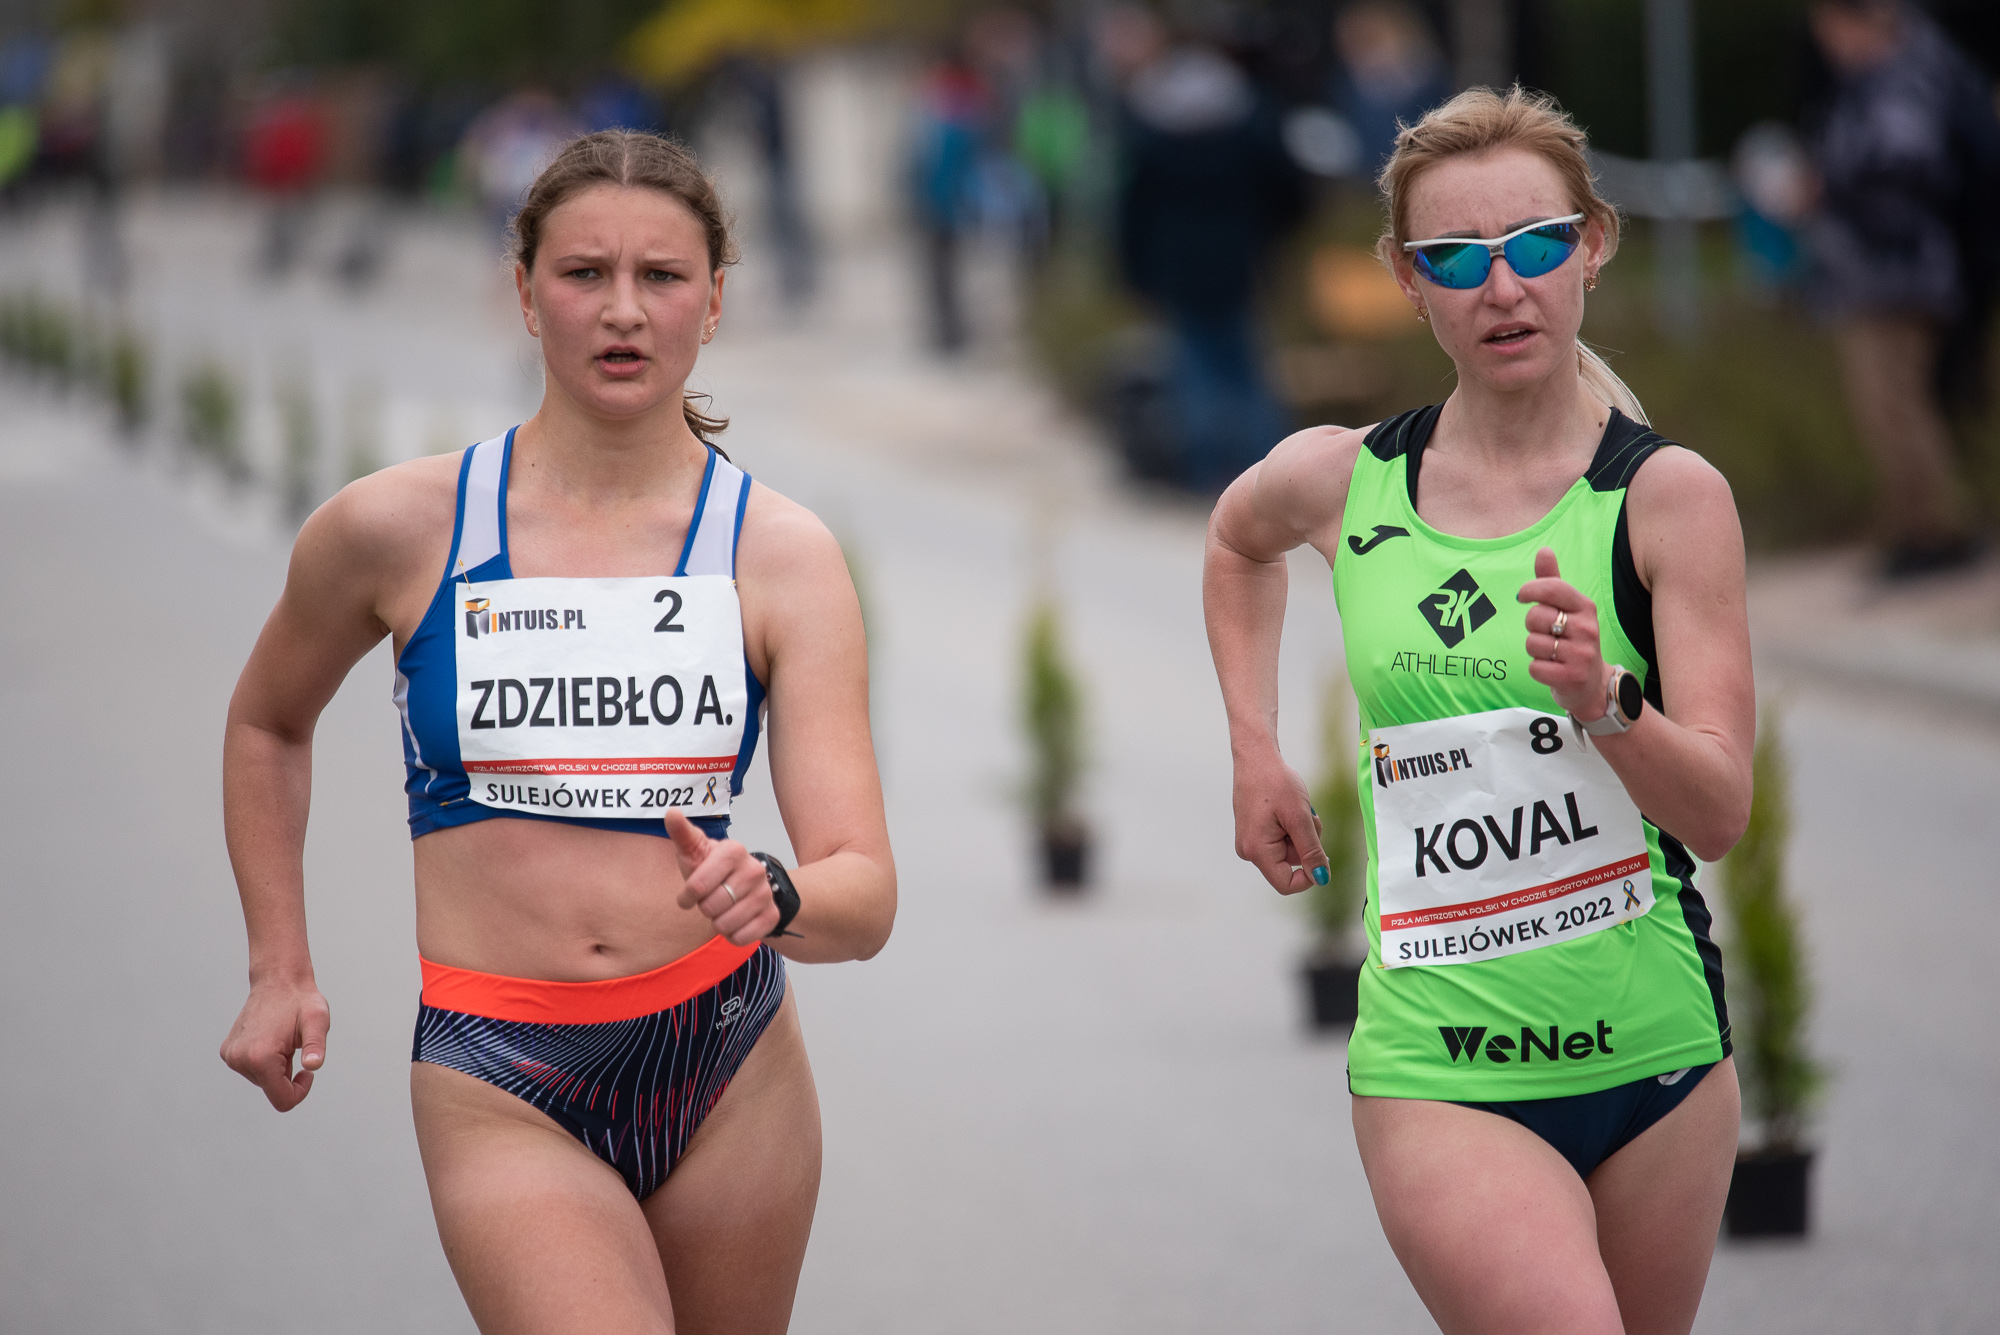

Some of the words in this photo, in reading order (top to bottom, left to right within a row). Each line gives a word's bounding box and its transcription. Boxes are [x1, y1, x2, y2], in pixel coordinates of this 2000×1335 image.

[491, 609, 587, 633] INTUIS.PL
[653, 589, 685, 633] 2
[1390, 651, 1507, 681] ATHLETICS
[470, 674, 684, 730] ZDZIEBŁO
[692, 675, 733, 726] A.
[1528, 716, 1563, 755] 8
[497, 764, 557, 772] MISTRZOSTWA
[558, 764, 589, 772] POLSKI
[600, 763, 638, 771] CHODZIE
[639, 763, 696, 771] SPORTOWYM
[1392, 748, 1473, 781] INTUIS.PL
[486, 782, 632, 808] SULEJÓWEK
[640, 786, 694, 808] 2022
[1414, 791, 1599, 878] KOVAL
[1391, 917, 1413, 927] PZLA
[1414, 909, 1469, 923] MISTRZOSTWA
[1469, 902, 1500, 916] POLSKI
[1500, 899, 1509, 908] W
[1510, 890, 1548, 906] CHODZIE
[1549, 873, 1603, 897] SPORTOWYM
[1603, 869, 1616, 879] NA
[1616, 866, 1628, 875] 20
[1628, 861, 1642, 872] KM
[1399, 916, 1550, 960] SULEJÓWEK
[1555, 896, 1615, 932] 2022
[1437, 1019, 1614, 1064] WeNet
